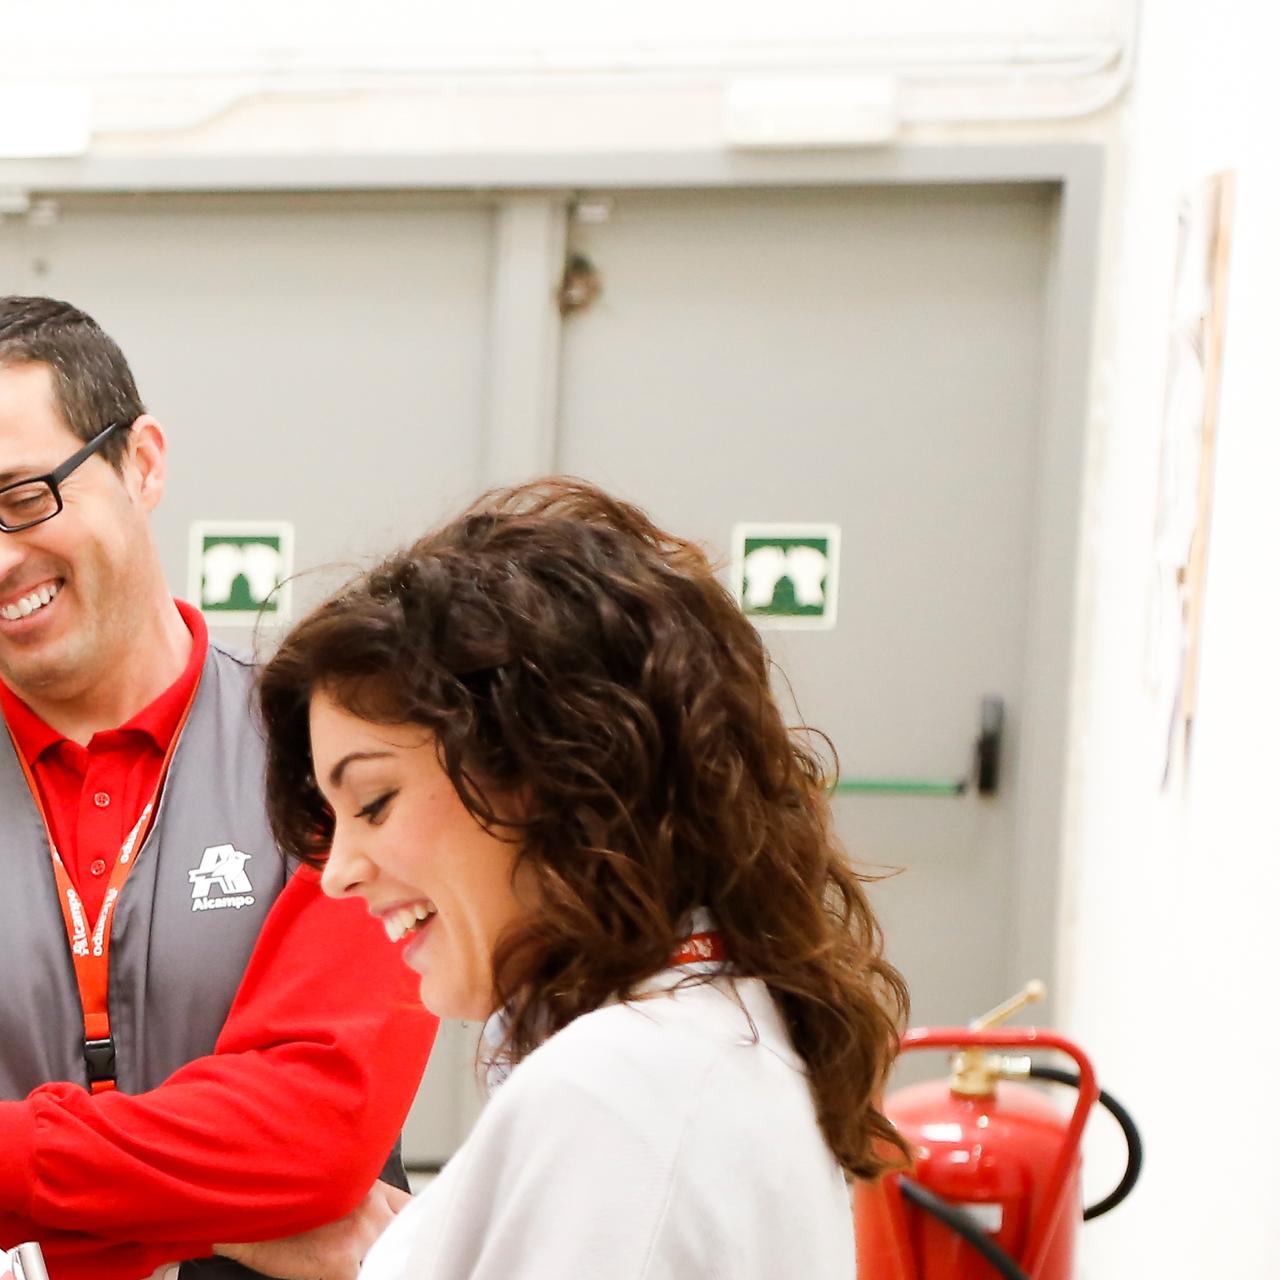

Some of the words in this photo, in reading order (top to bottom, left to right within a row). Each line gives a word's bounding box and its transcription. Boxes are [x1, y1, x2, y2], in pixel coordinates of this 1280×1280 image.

[66, 888, 90, 957] Alcampo
[91, 887, 119, 957] Alcampo
[191, 896, 255, 912] Alcampo
